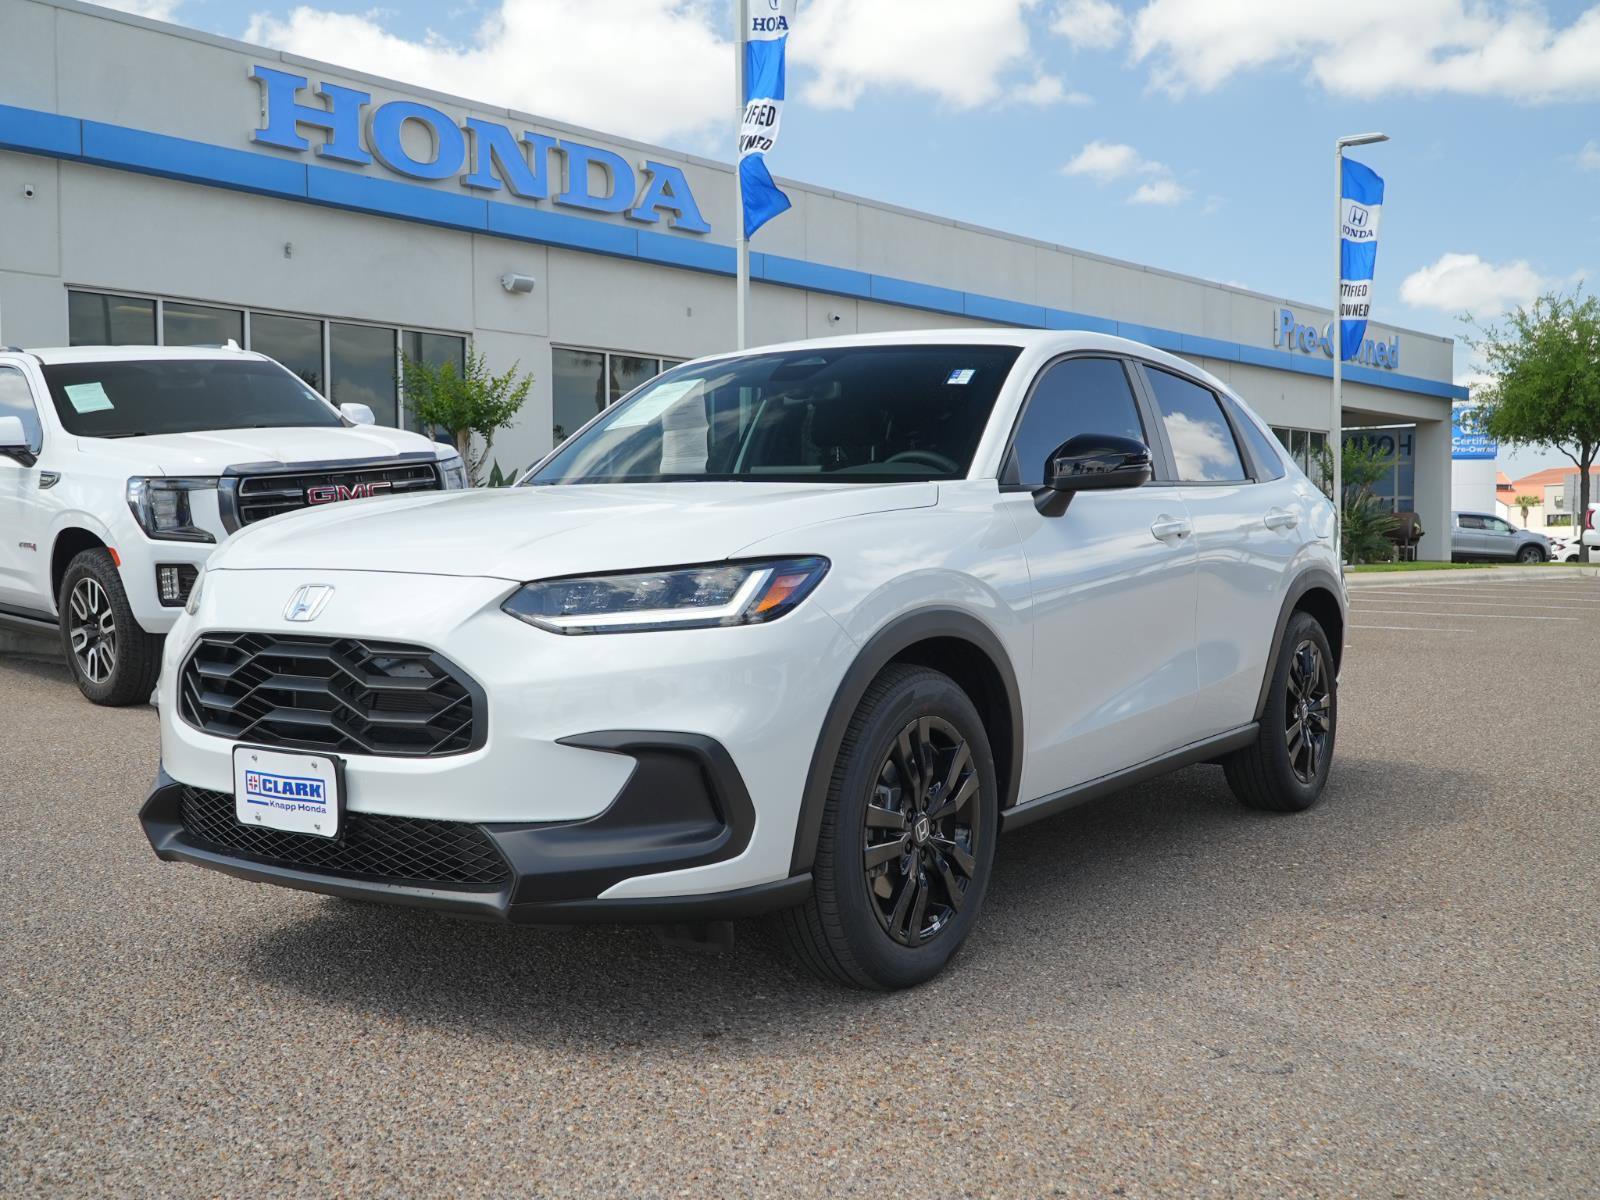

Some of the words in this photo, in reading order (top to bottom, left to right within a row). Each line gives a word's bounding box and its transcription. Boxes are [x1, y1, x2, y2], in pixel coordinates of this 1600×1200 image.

[745, 104, 776, 126] IFIED
[248, 65, 711, 233] HONDA
[1274, 306, 1400, 369] Pre-ned
[307, 481, 391, 504] GMC
[262, 778, 322, 798] CLARK
[269, 799, 297, 812] Knapp
[298, 803, 327, 814] Honda
